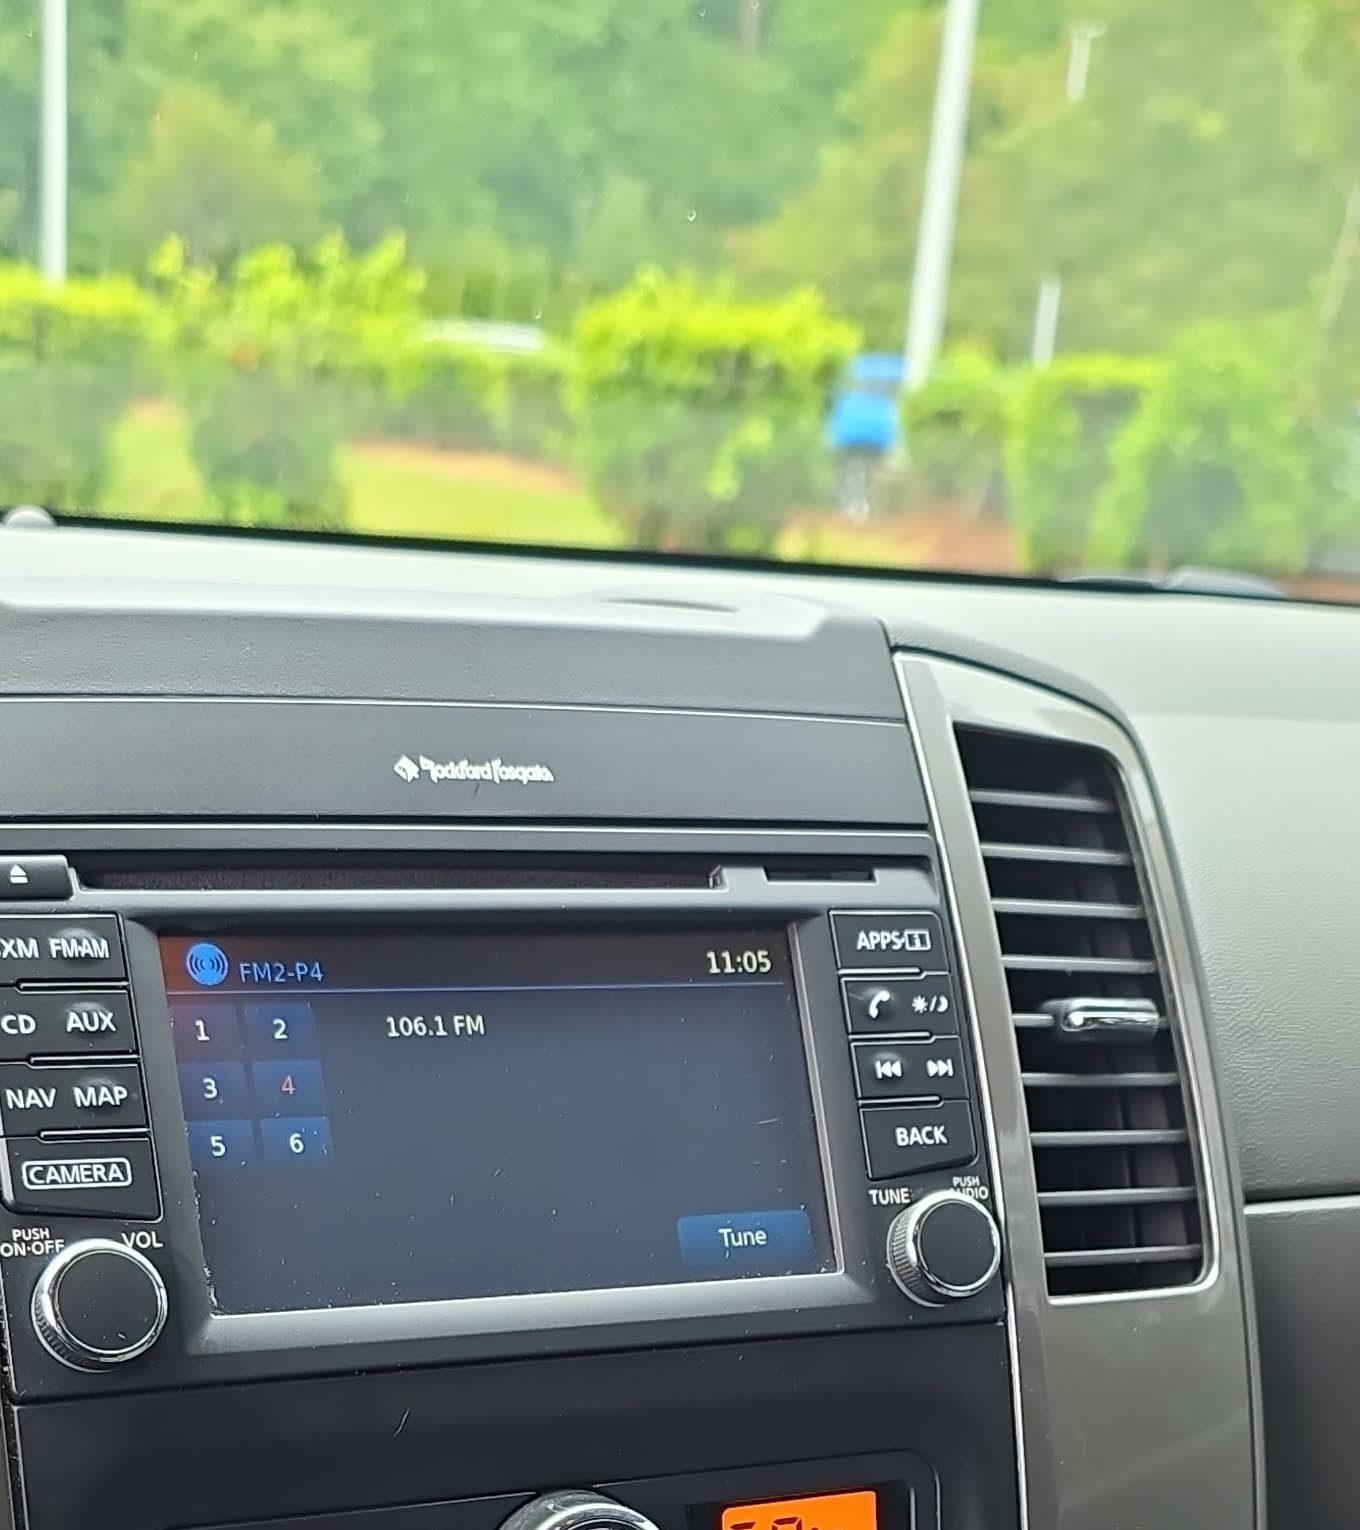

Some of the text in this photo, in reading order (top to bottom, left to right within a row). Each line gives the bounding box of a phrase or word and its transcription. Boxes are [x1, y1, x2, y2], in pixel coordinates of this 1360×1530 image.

[239, 962, 324, 984] FM2-P4
[706, 950, 772, 974] 11:05
[1, 1009, 117, 1035] CD AUX
[195, 1018, 288, 1041] 1 2
[385, 1014, 486, 1038] 106.1 FM
[6, 1085, 128, 1109] NAV MAP
[203, 1075, 296, 1099] 3 4
[211, 1132, 305, 1157] 5 6
[895, 1125, 947, 1147] BACK
[28, 1163, 124, 1185] CAMERA
[952, 1175, 981, 1187] PUSH
[867, 1187, 912, 1205] TUNE
[11, 1227, 51, 1241] PUSH
[121, 1230, 164, 1249] VOL
[718, 1227, 768, 1248] Tune
